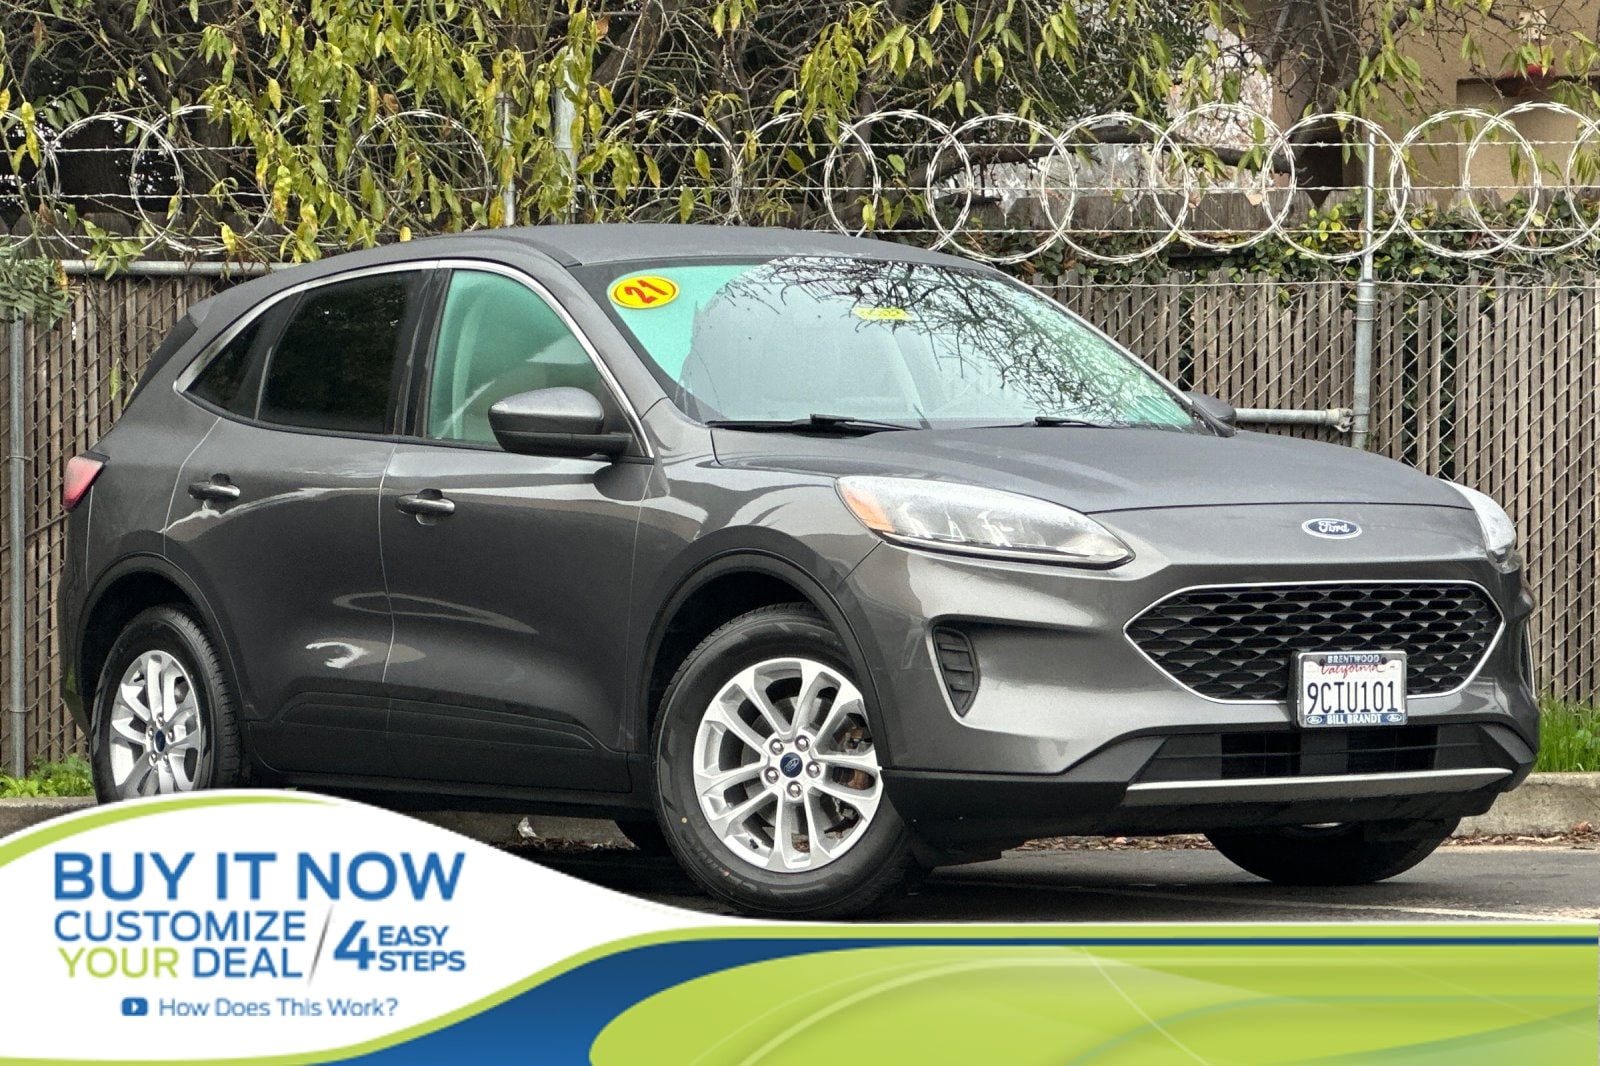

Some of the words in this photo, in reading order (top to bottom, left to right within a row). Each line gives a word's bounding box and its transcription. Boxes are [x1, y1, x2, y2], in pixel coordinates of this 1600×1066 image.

[623, 279, 669, 304] 21
[1318, 520, 1351, 533] Ford
[1327, 654, 1380, 664] BRENTWOOD
[1307, 681, 1398, 714] 9CIU101
[1326, 715, 1346, 725] BILL
[1347, 714, 1382, 724] BRANDT
